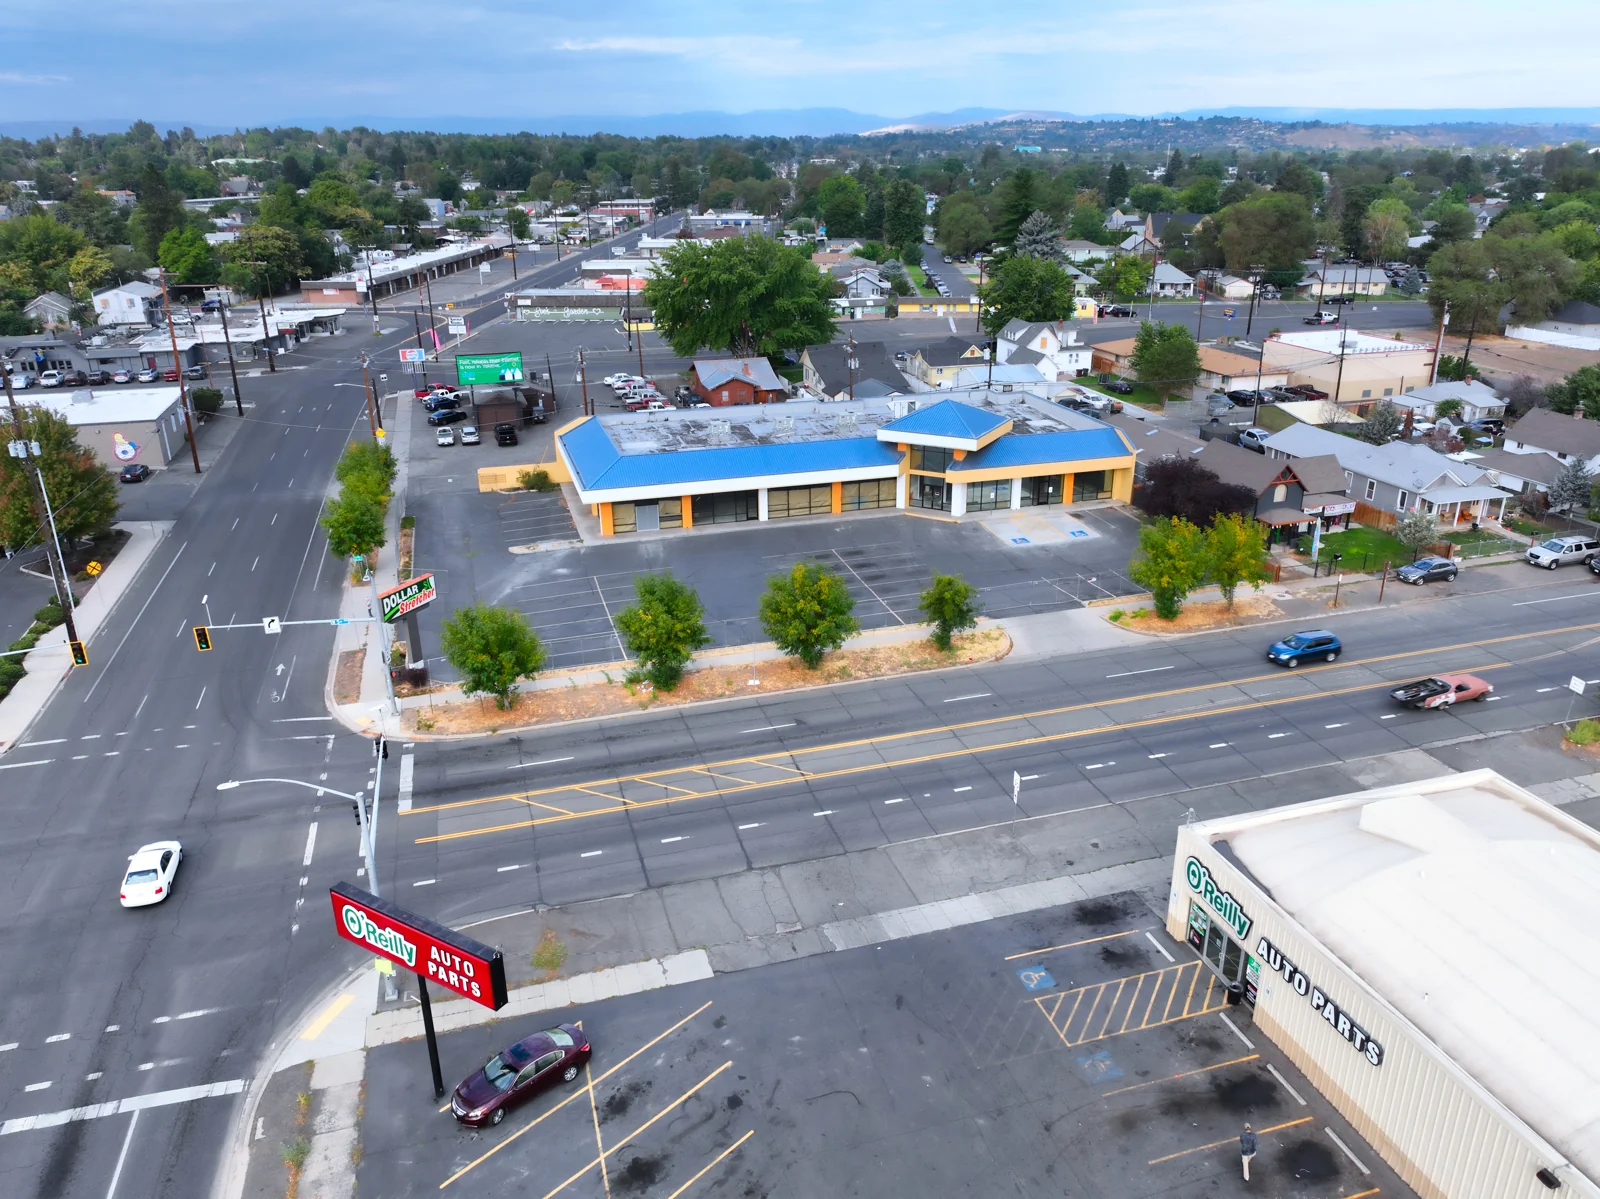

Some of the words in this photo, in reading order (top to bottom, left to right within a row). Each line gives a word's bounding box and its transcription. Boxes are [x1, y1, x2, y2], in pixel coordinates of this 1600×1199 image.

[383, 584, 419, 614] DOLLAR
[400, 587, 435, 615] Stretcher
[1186, 858, 1249, 937] O'Reilly
[343, 906, 415, 965] O'Reilly
[427, 960, 482, 998] PARTS
[430, 945, 475, 978] AUTO
[1256, 938, 1309, 996] AUTO
[1310, 987, 1382, 1066] PARTS
